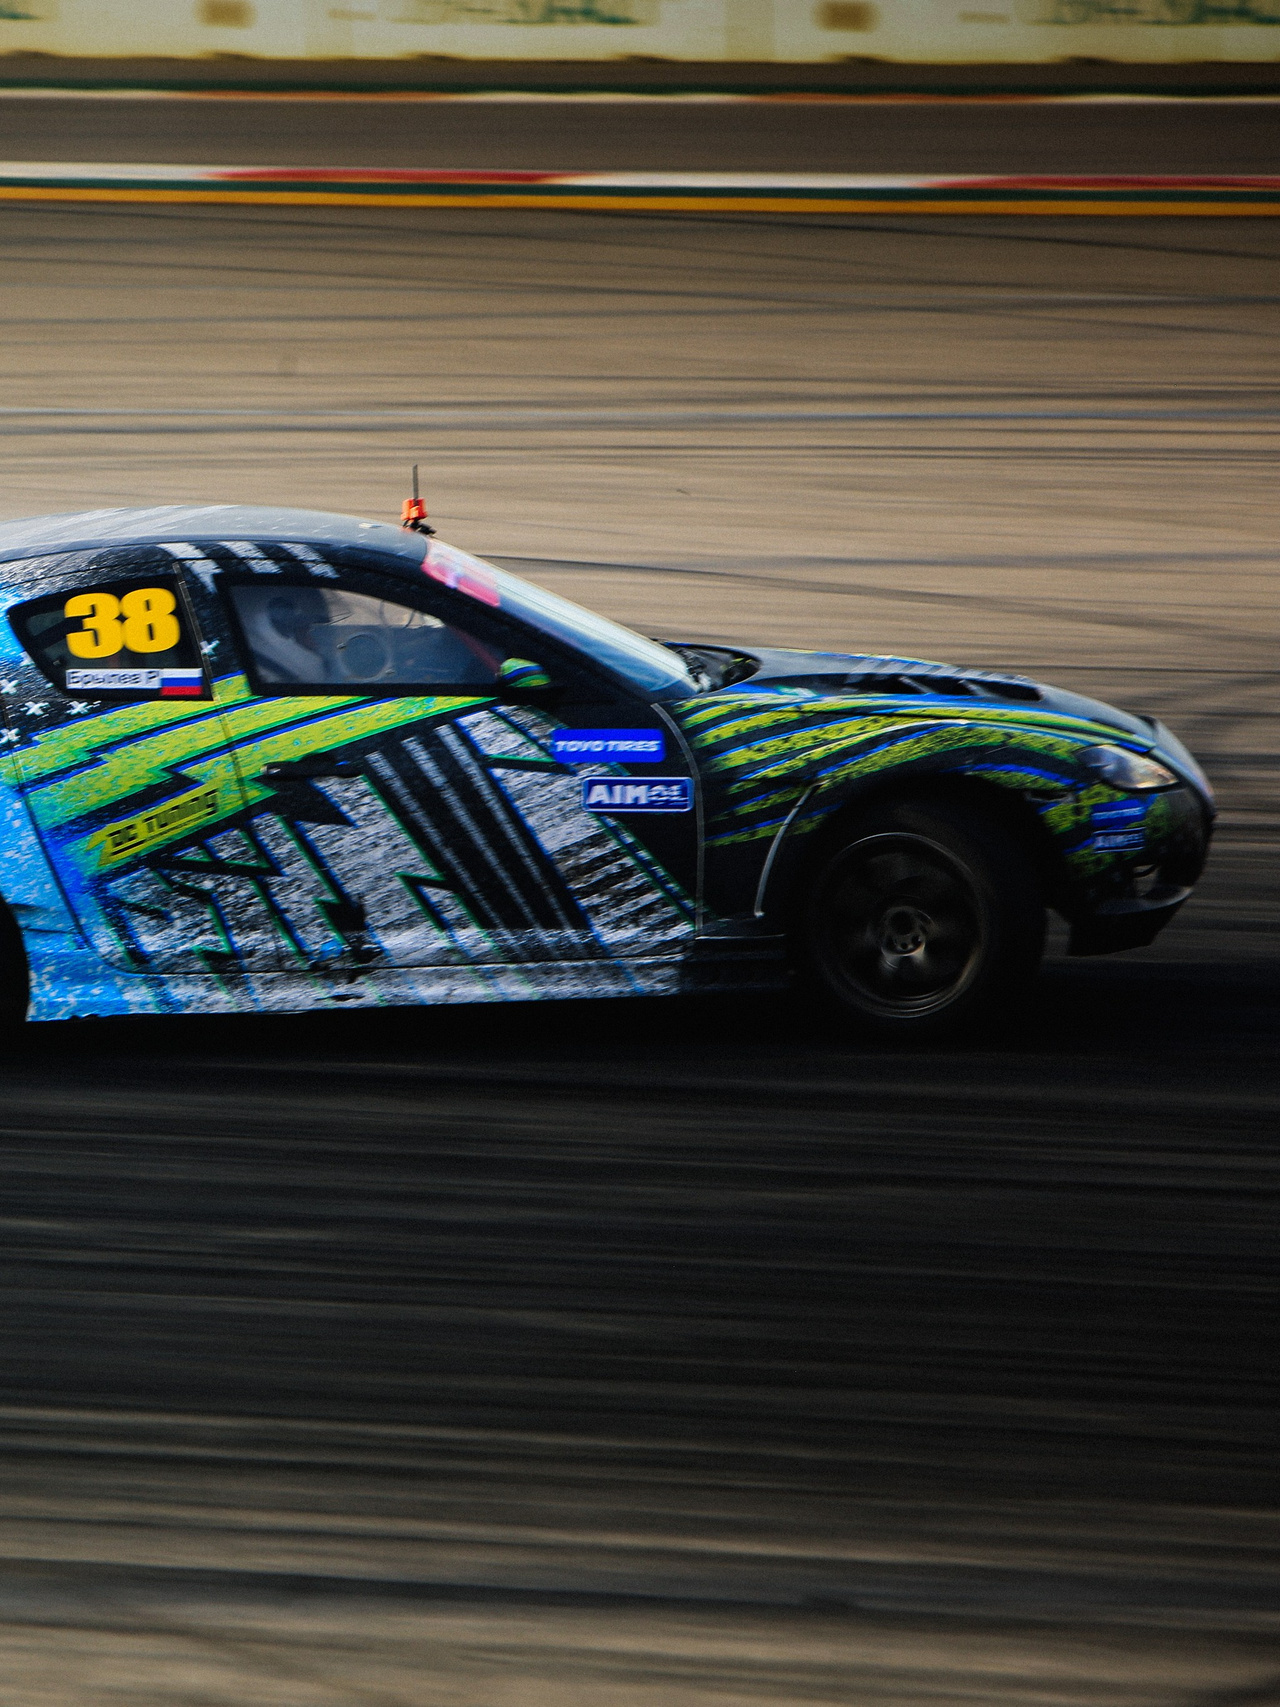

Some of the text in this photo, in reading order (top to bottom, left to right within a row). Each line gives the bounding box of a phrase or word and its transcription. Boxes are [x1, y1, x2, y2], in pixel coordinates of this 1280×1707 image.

[64, 588, 180, 658] 38
[555, 740, 659, 752] TOYO TIRES
